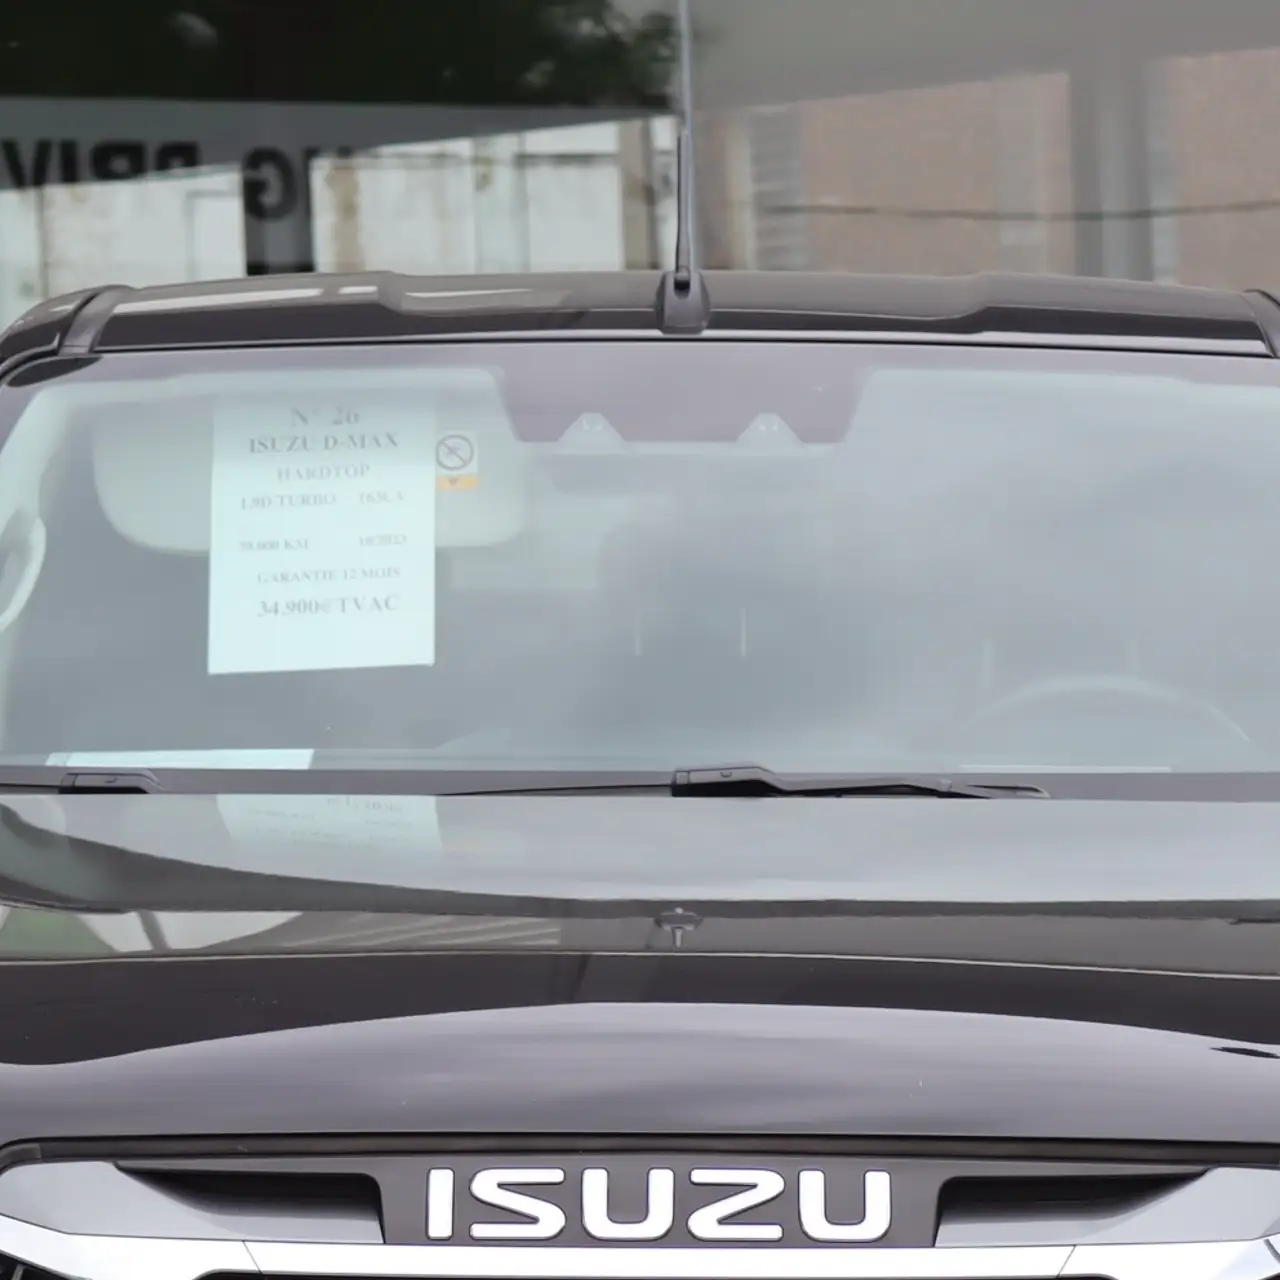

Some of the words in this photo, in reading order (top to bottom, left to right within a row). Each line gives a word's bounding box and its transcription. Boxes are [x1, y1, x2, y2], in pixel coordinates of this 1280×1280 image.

[249, 434, 316, 454] ISUZU
[323, 431, 400, 451] D-MAX
[276, 463, 371, 482] HARDTOP
[275, 492, 337, 508] TURBO
[425, 1166, 893, 1244] ISUZU
